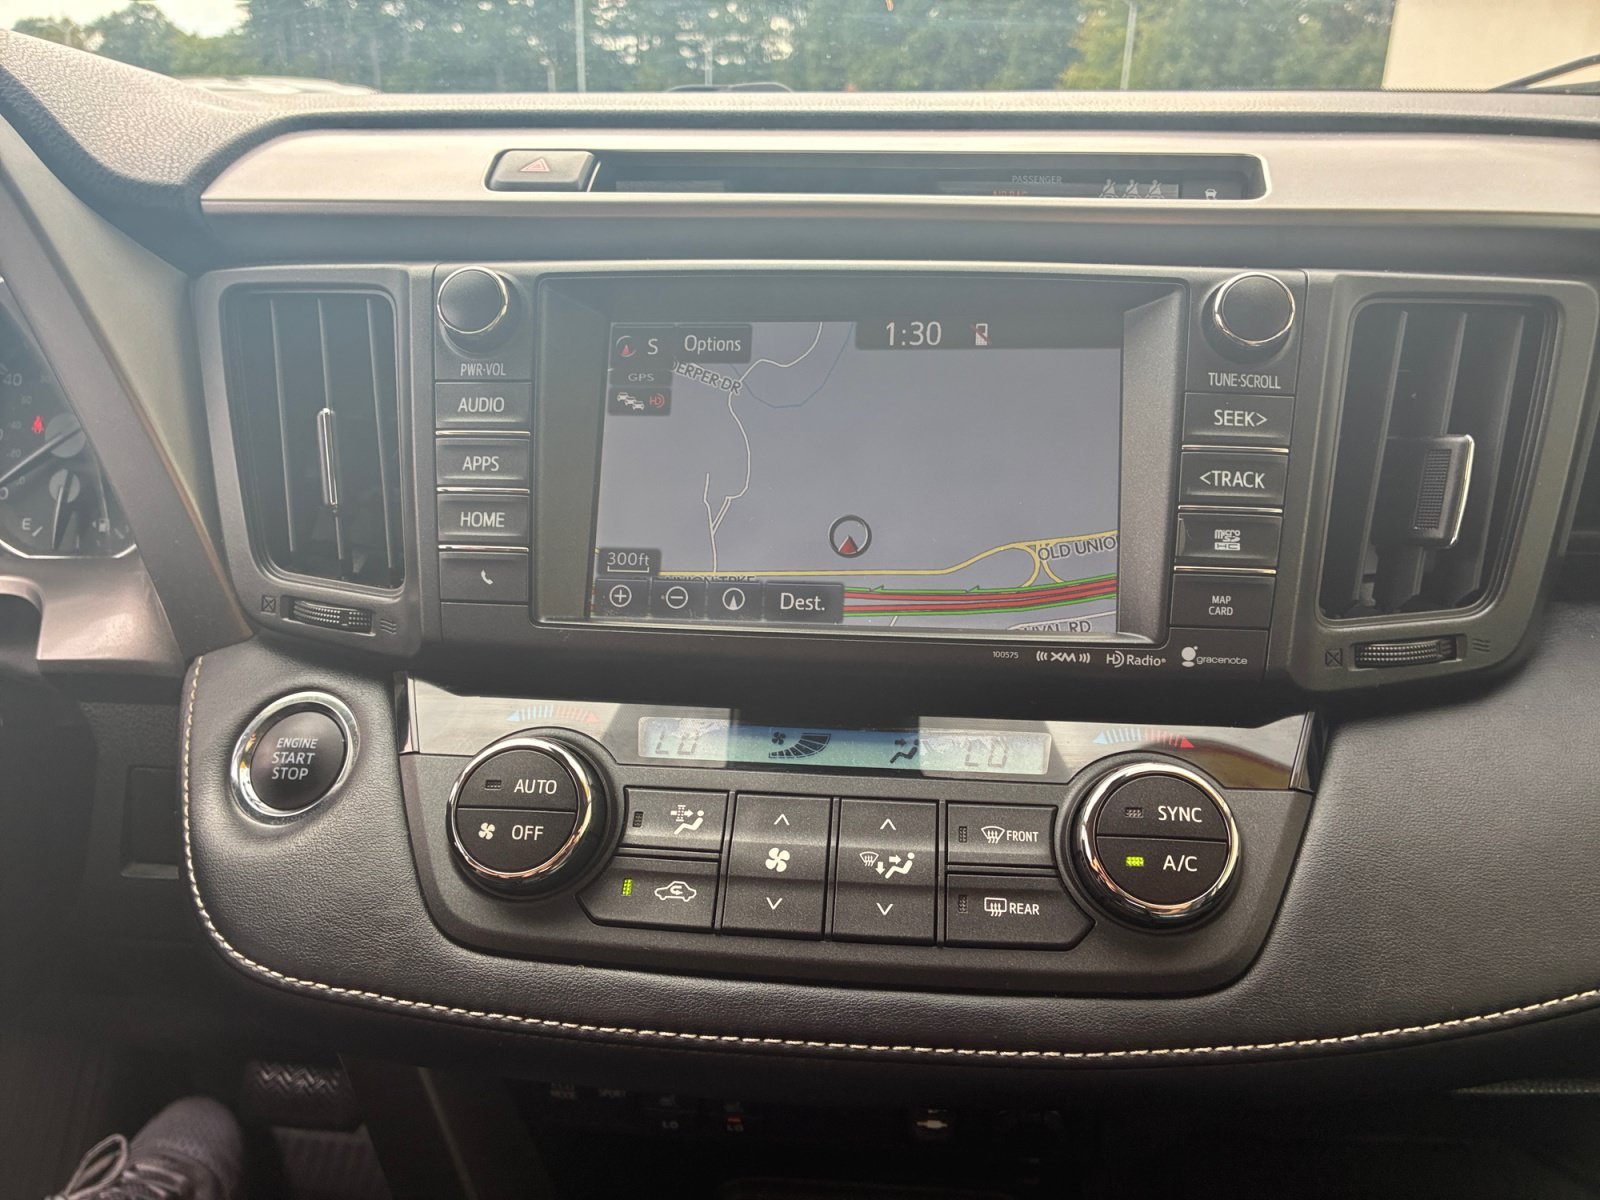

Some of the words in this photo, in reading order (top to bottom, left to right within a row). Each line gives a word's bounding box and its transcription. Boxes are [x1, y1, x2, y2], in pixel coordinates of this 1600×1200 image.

[1011, 175, 1063, 185] PASSENGER
[886, 321, 942, 346] 1:30
[647, 338, 659, 355] S
[684, 334, 742, 356] Options
[628, 373, 655, 382] GPS
[720, 379, 742, 395] DR
[457, 397, 505, 413] AUDIO
[462, 456, 500, 471] APPS
[22, 518, 32, 530] E
[460, 512, 506, 528] HOME
[1037, 544, 1071, 561] OLD
[1074, 536, 1116, 555] UNIO
[607, 552, 650, 567] 300ft
[780, 593, 826, 611] Dest.
[1211, 595, 1232, 605] MAP
[1208, 606, 1234, 616] CARD
[1069, 621, 1091, 632] RD
[992, 651, 1019, 659] 100575
[1196, 656, 1248, 666] gracenote
[276, 737, 319, 749] ENGINE
[271, 751, 315, 765] START
[271, 767, 309, 780] STOP
[513, 779, 558, 795] AUTO
[1157, 805, 1203, 823] SYNC
[511, 824, 544, 841] OFF
[1006, 830, 1039, 842] FRONT
[1162, 854, 1198, 872] A/C
[1009, 902, 1040, 916] REAR
